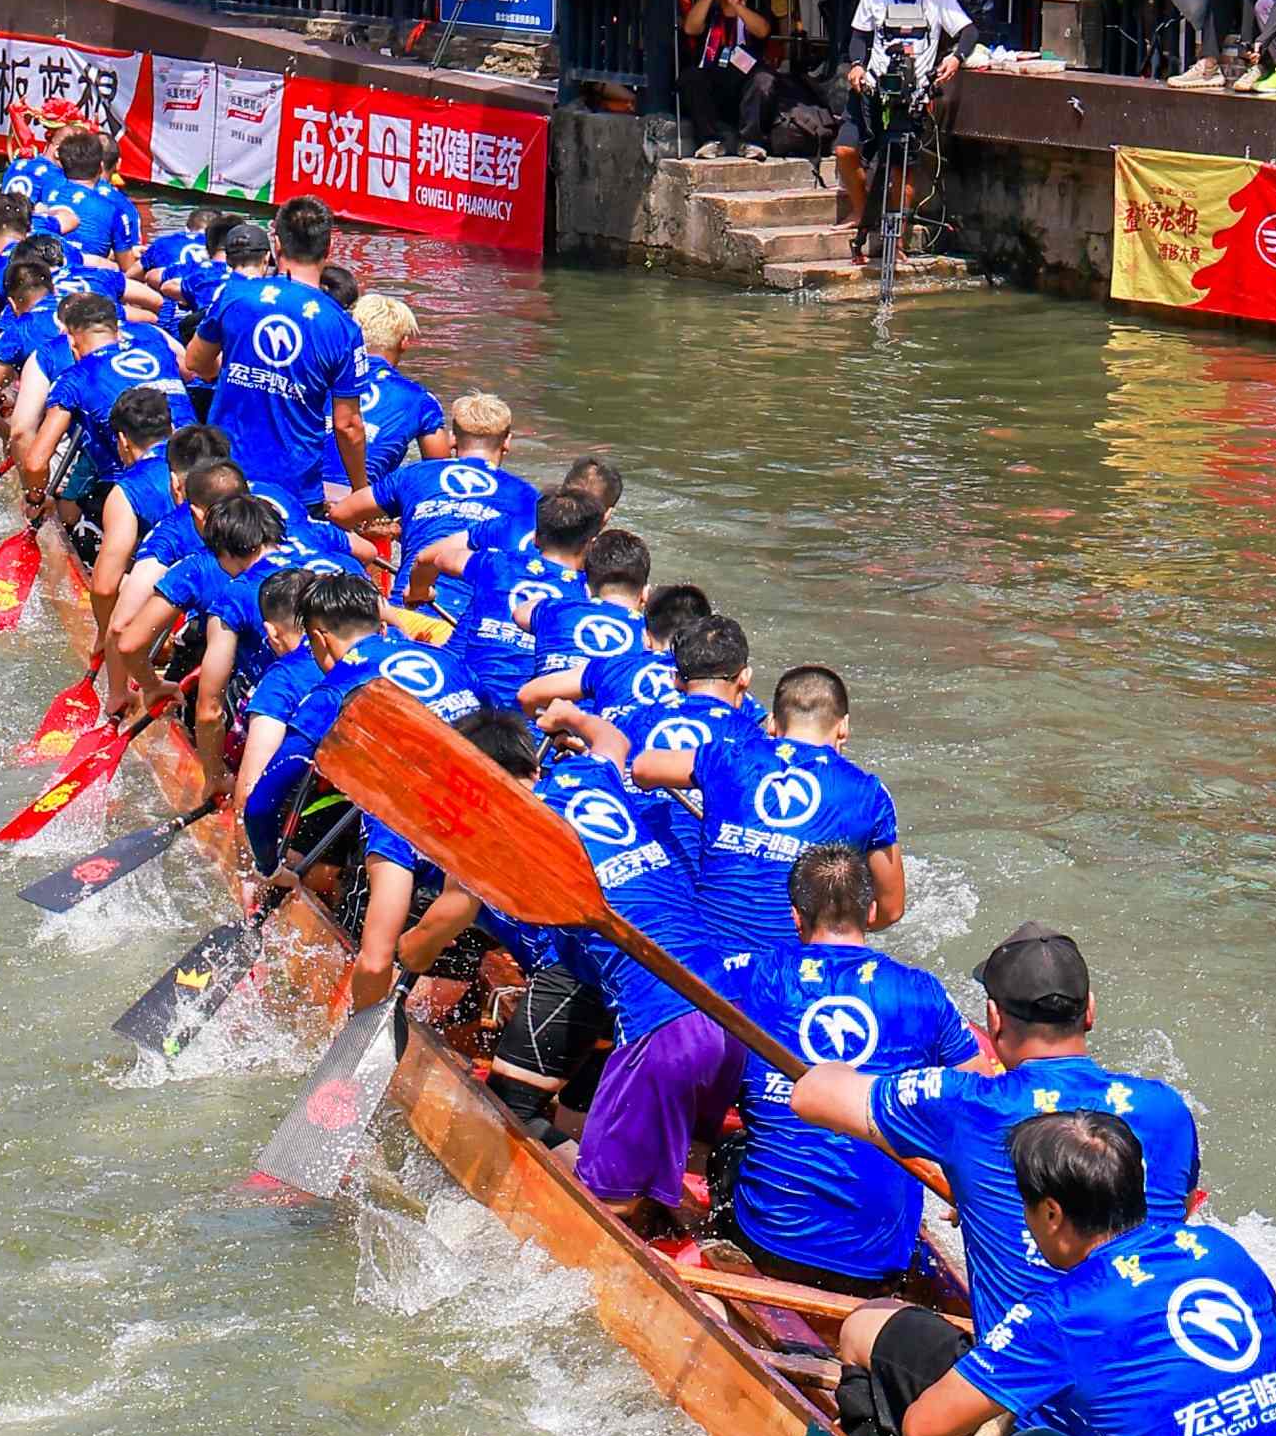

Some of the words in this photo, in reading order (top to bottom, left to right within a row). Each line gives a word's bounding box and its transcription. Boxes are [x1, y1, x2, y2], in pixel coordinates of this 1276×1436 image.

[291, 104, 364, 193] 高济
[417, 123, 523, 191] 邦健医药
[415, 185, 454, 212] COWELL
[456, 192, 513, 222] PHARMACY
